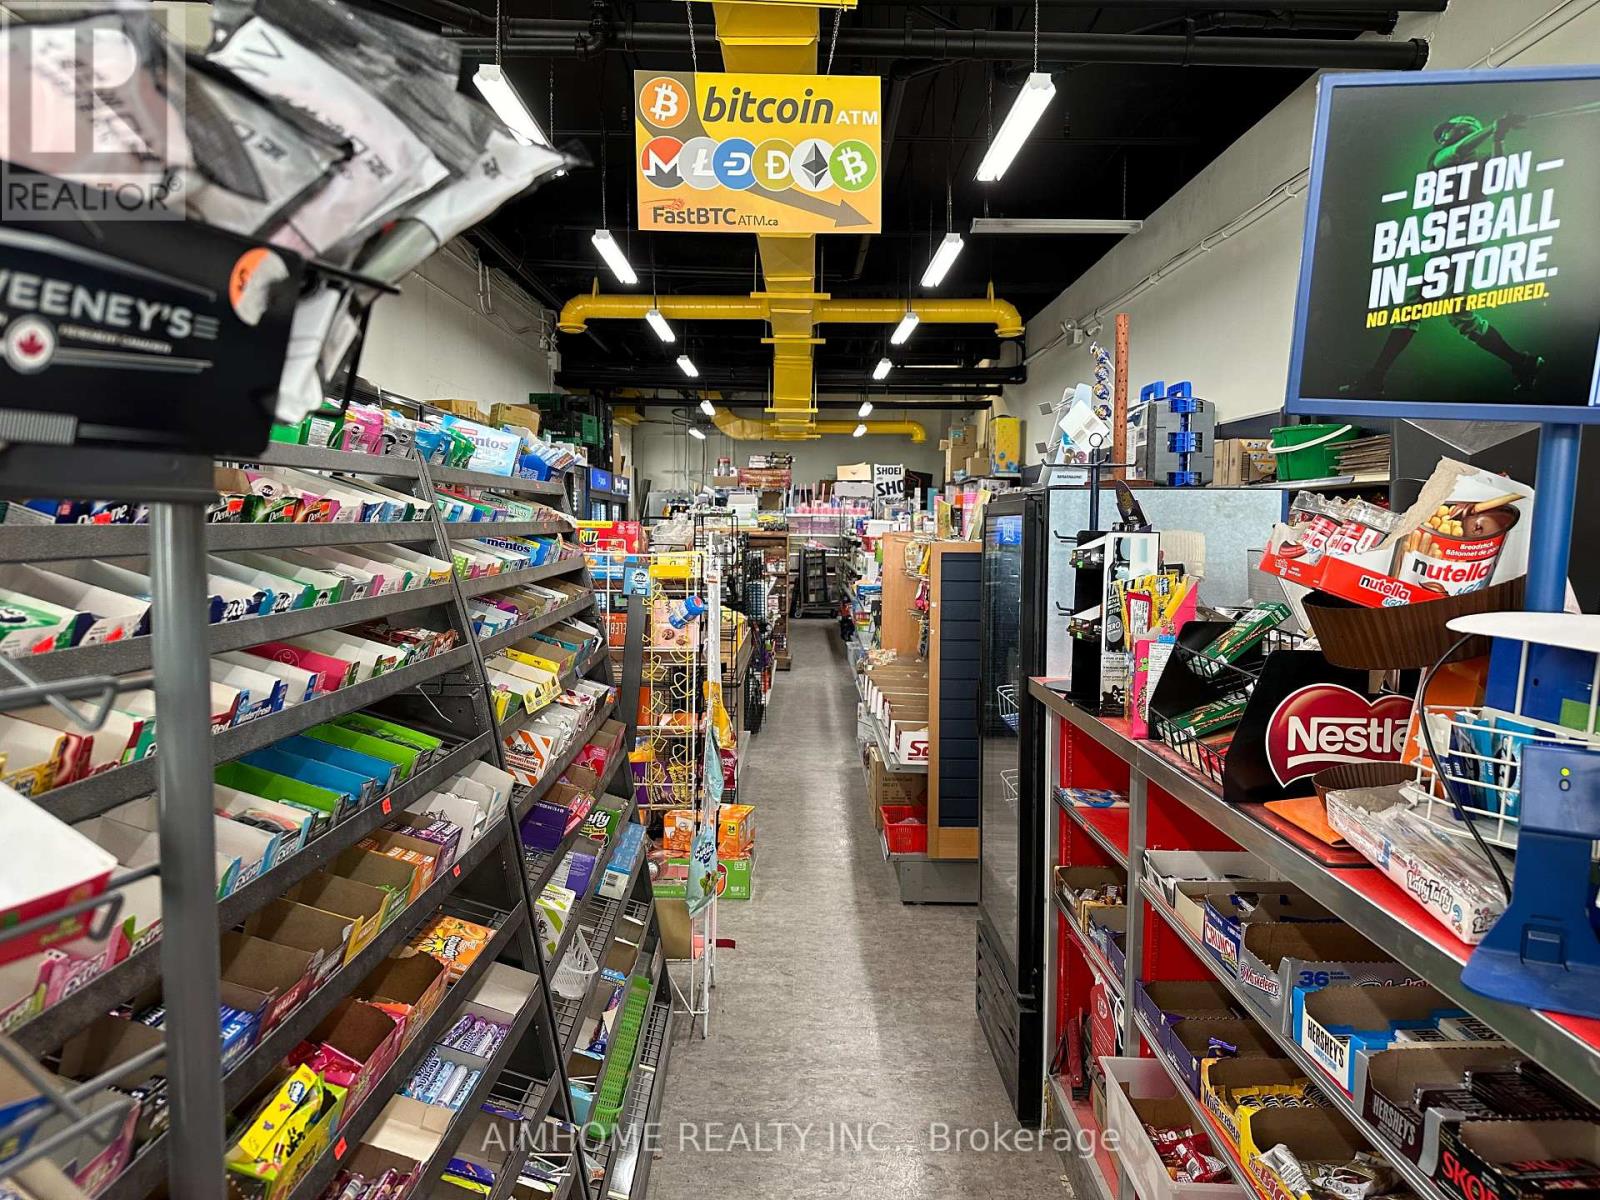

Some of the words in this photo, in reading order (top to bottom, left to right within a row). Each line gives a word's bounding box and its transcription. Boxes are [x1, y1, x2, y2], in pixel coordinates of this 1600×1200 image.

[703, 86, 834, 124] bitcoin
[835, 110, 879, 126] ATM
[1412, 161, 1478, 210] BET
[1481, 150, 1532, 196] ON
[1371, 188, 1561, 264] BASEBALL
[1367, 235, 1559, 309] IN-STORE.
[0, 268, 194, 338] EENEY'S
[1366, 310, 1388, 328] NO
[1390, 297, 1464, 324] ACCOUNT
[1465, 281, 1550, 312] REQUIRED.
[470, 434, 510, 451] entos
[487, 538, 531, 553] mentos
[579, 529, 600, 543] RITZ
[1359, 575, 1410, 600] nutella
[1412, 557, 1492, 583] nutella
[1407, 871, 1429, 904] Laffy
[1429, 879, 1453, 915] Taffy
[1205, 922, 1236, 961] CRUNCH
[1246, 966, 1279, 996] Musketeers
[1299, 970, 1330, 988] 36
[1307, 1020, 1345, 1069] HERSHEY'S
[1372, 1094, 1416, 1146] HERSHEY'S
